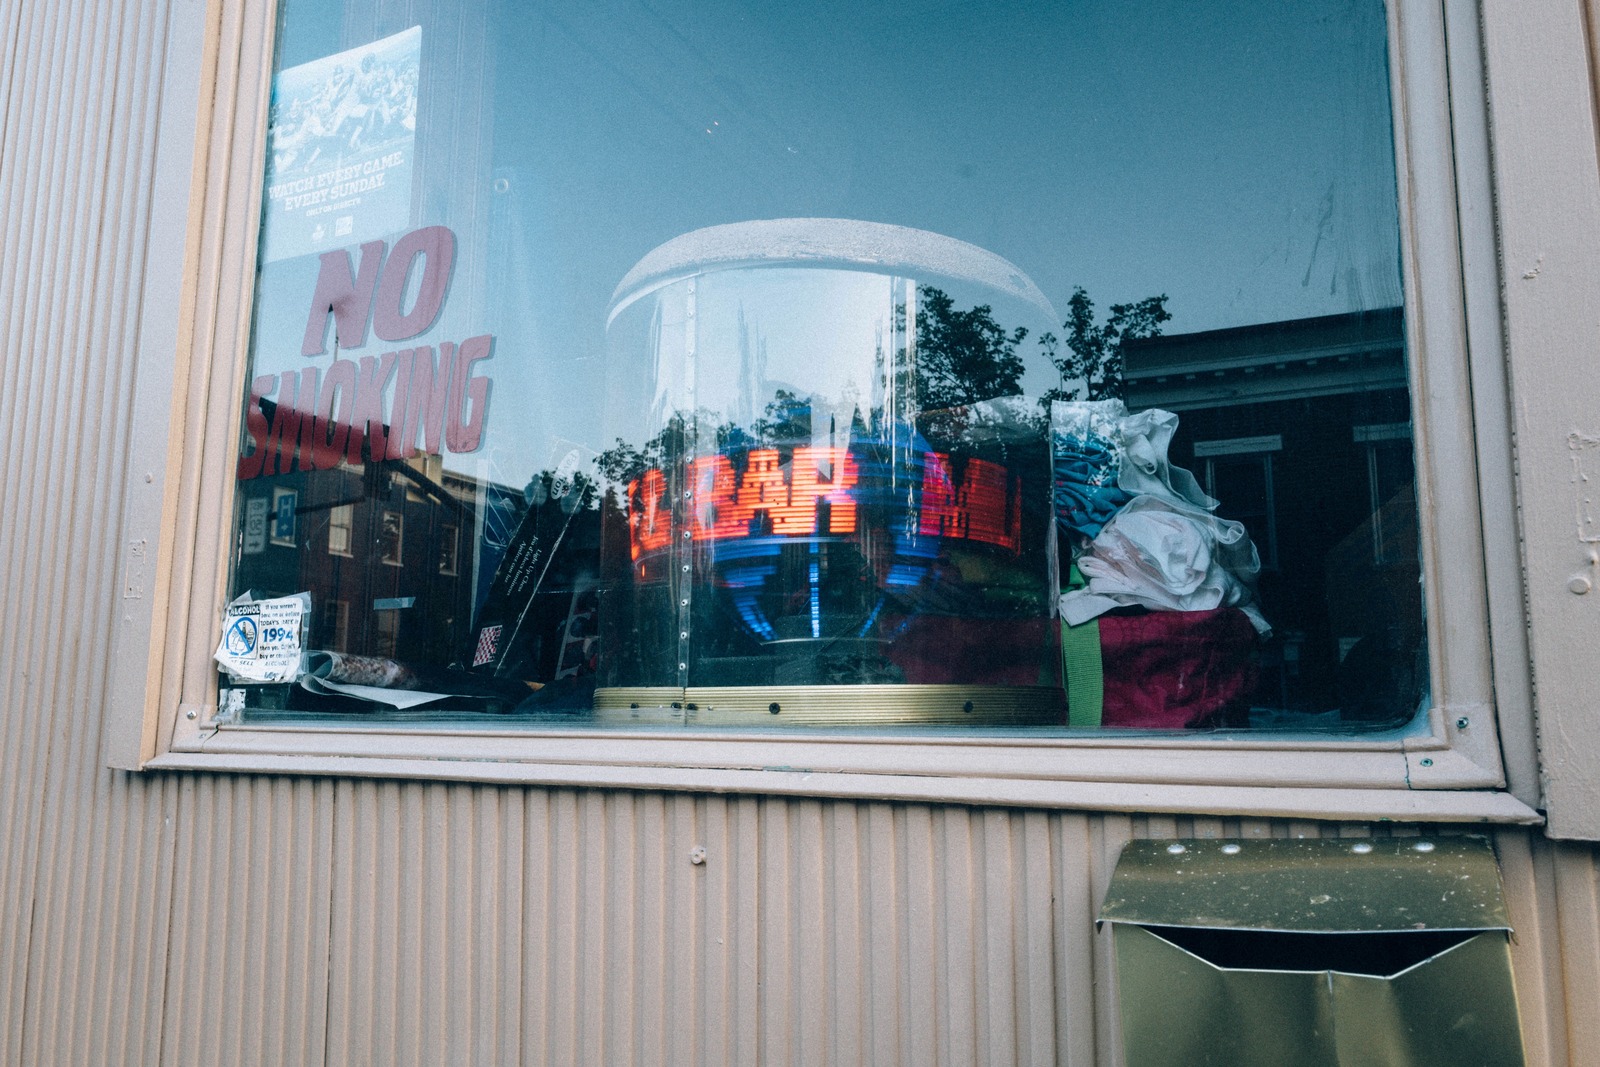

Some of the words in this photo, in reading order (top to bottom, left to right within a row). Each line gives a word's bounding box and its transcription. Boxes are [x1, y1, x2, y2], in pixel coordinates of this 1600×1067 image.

[269, 175, 315, 199] WATCH
[318, 164, 361, 187] EVERY
[285, 188, 329, 211] EVERY
[301, 226, 457, 356] NO
[238, 334, 496, 481] SMOKING
[531, 549, 542, 565] Light
[230, 604, 260, 617] ALCOHOL
[262, 627, 293, 643] 1994
